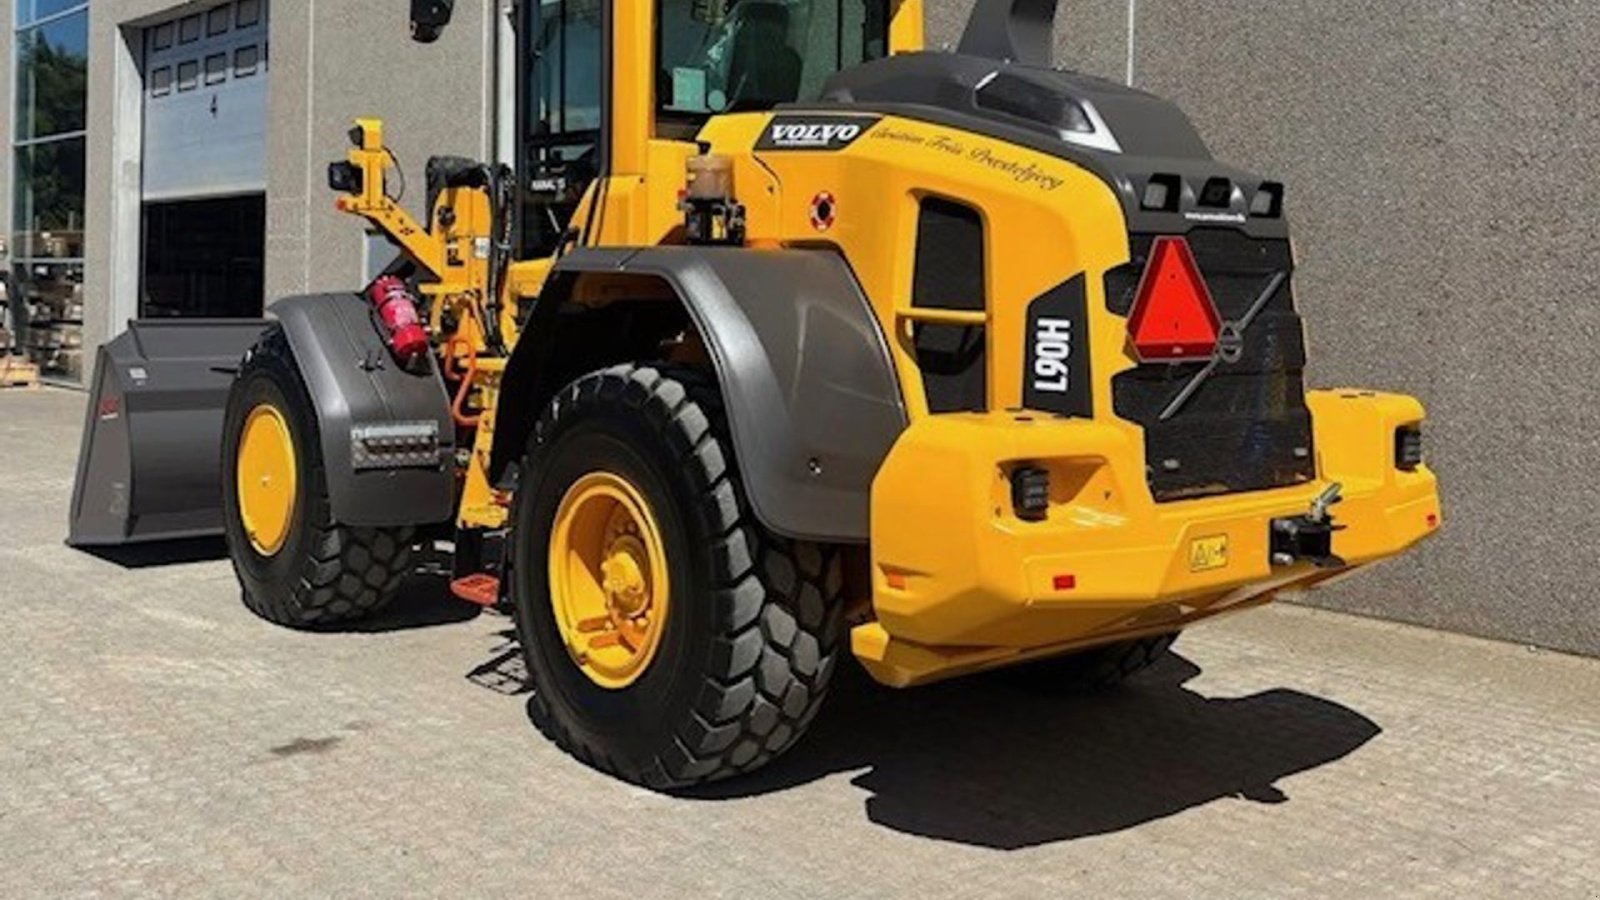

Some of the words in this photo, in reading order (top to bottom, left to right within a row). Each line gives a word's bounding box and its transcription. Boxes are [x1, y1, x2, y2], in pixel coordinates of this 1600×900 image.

[209, 94, 218, 118] 4
[772, 124, 860, 141] VOLVO
[1034, 318, 1070, 391] L90H
